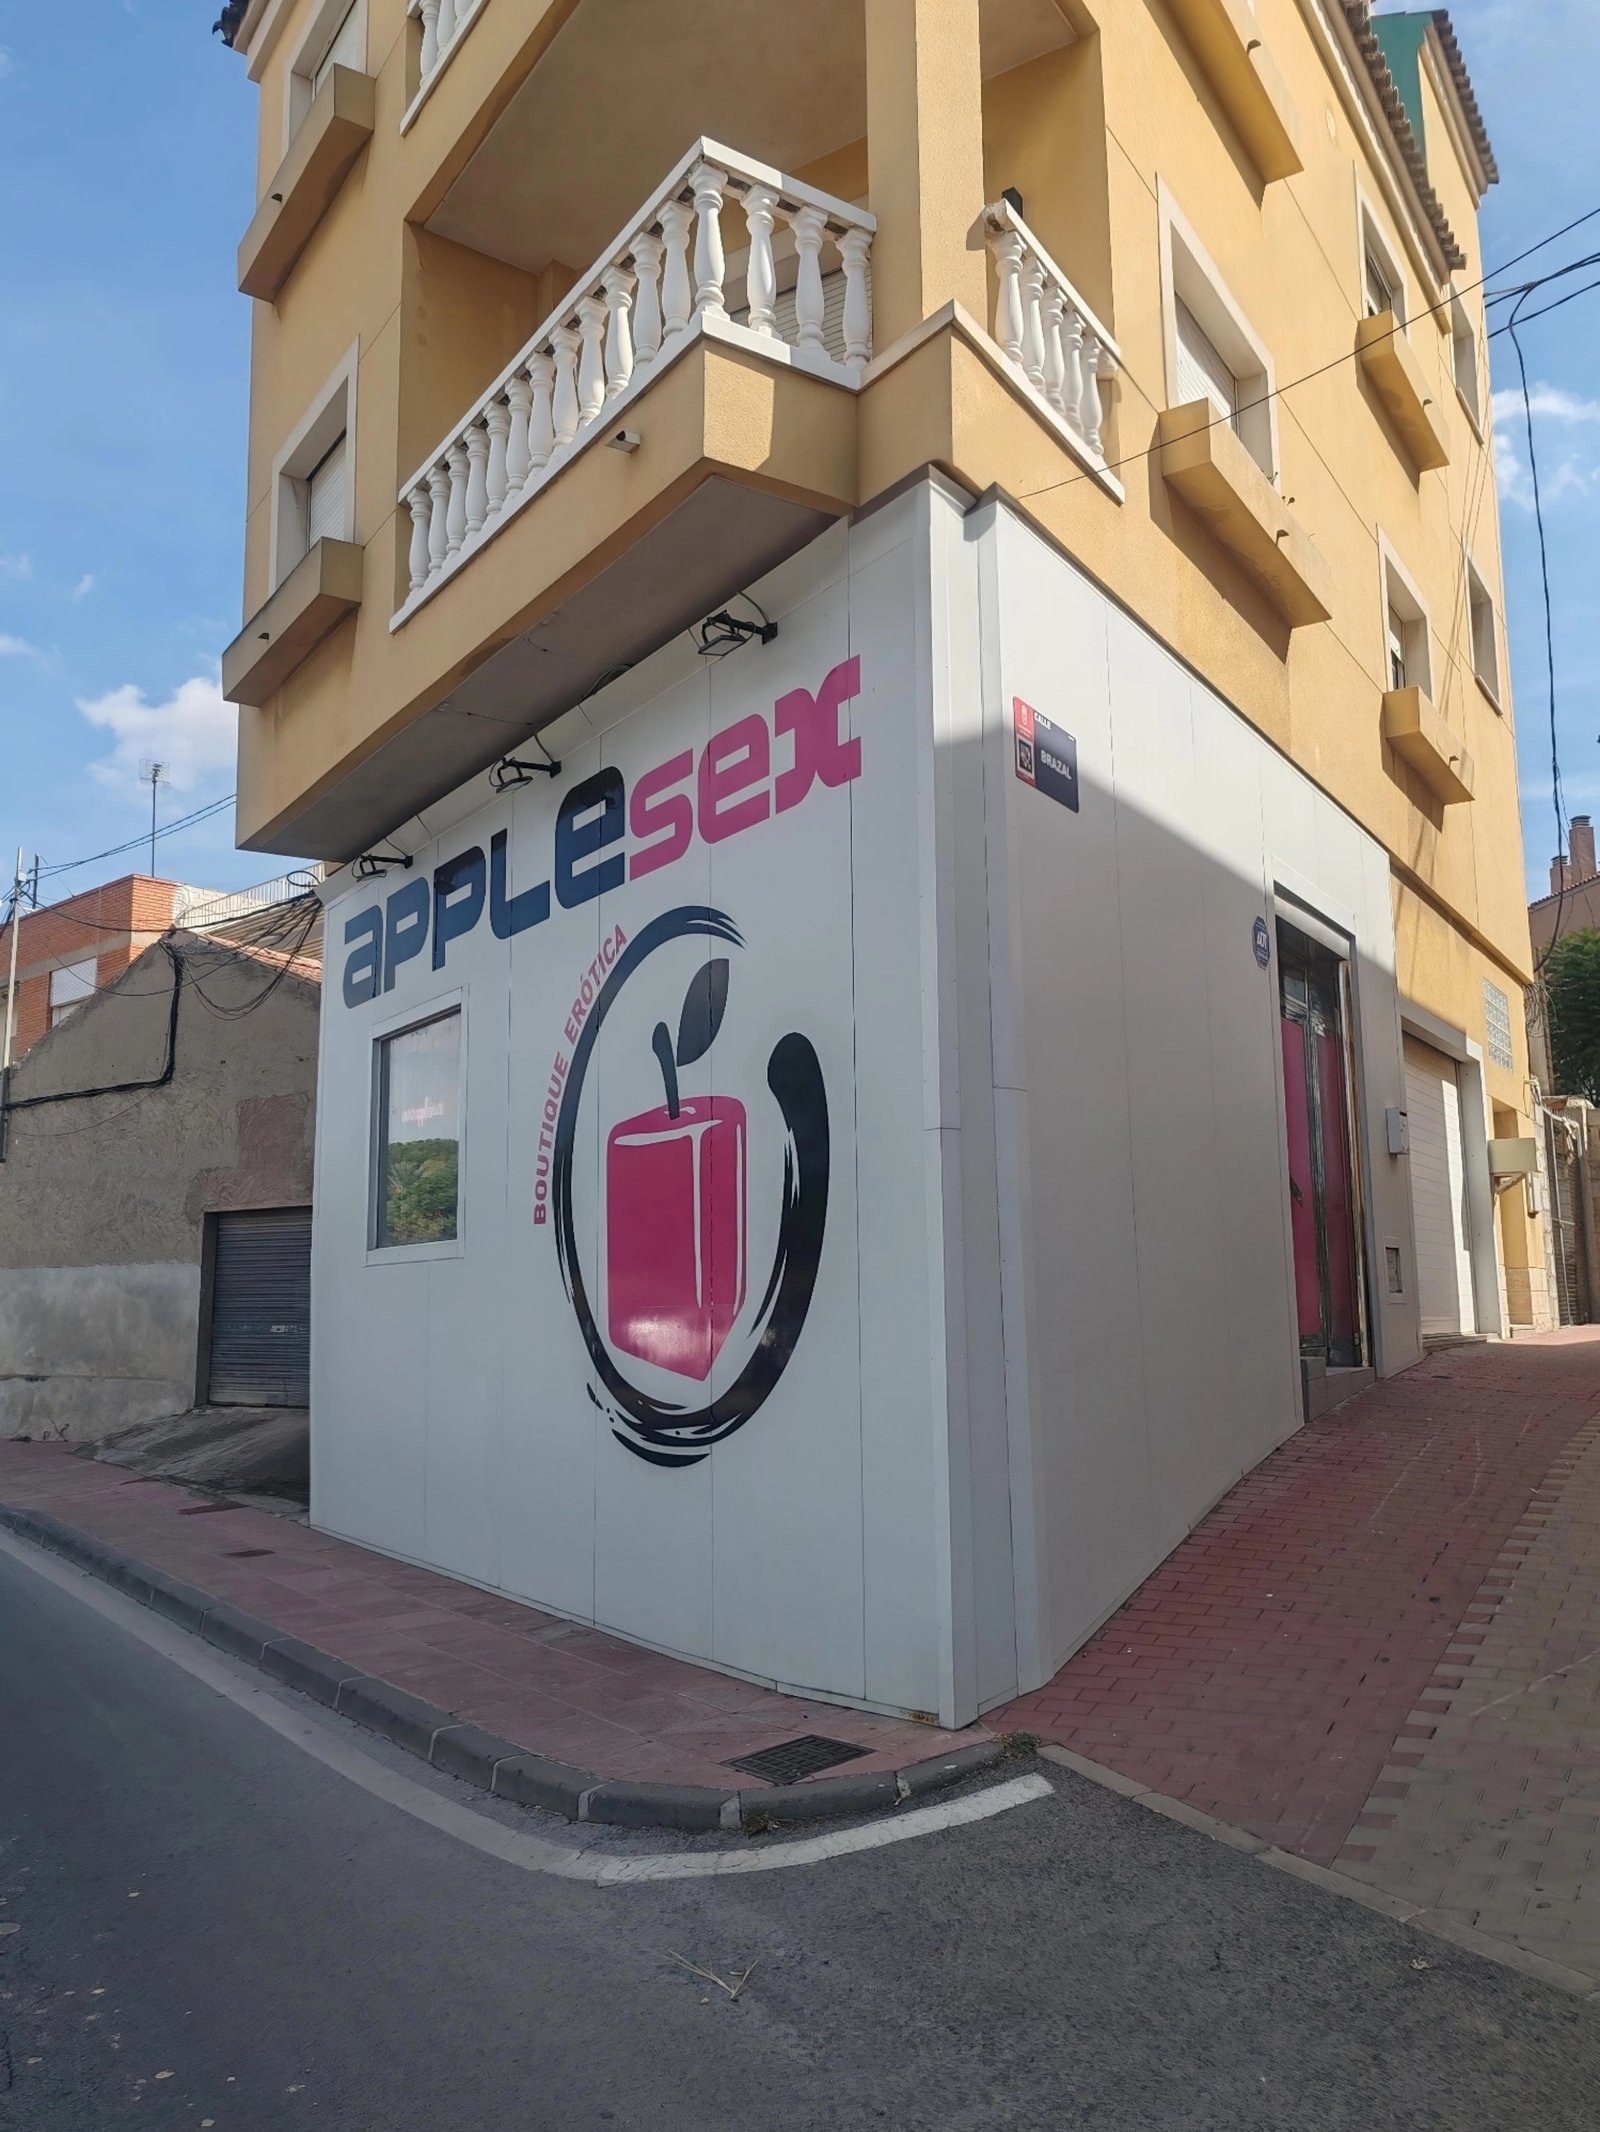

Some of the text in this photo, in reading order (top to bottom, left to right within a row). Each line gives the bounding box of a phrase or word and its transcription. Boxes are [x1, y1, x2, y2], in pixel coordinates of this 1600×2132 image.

[1034, 712, 1051, 730] CALLE
[1040, 750, 1072, 780] BRAZAL
[533, 924, 628, 1225] BOUTIQUE ERÓTICA
